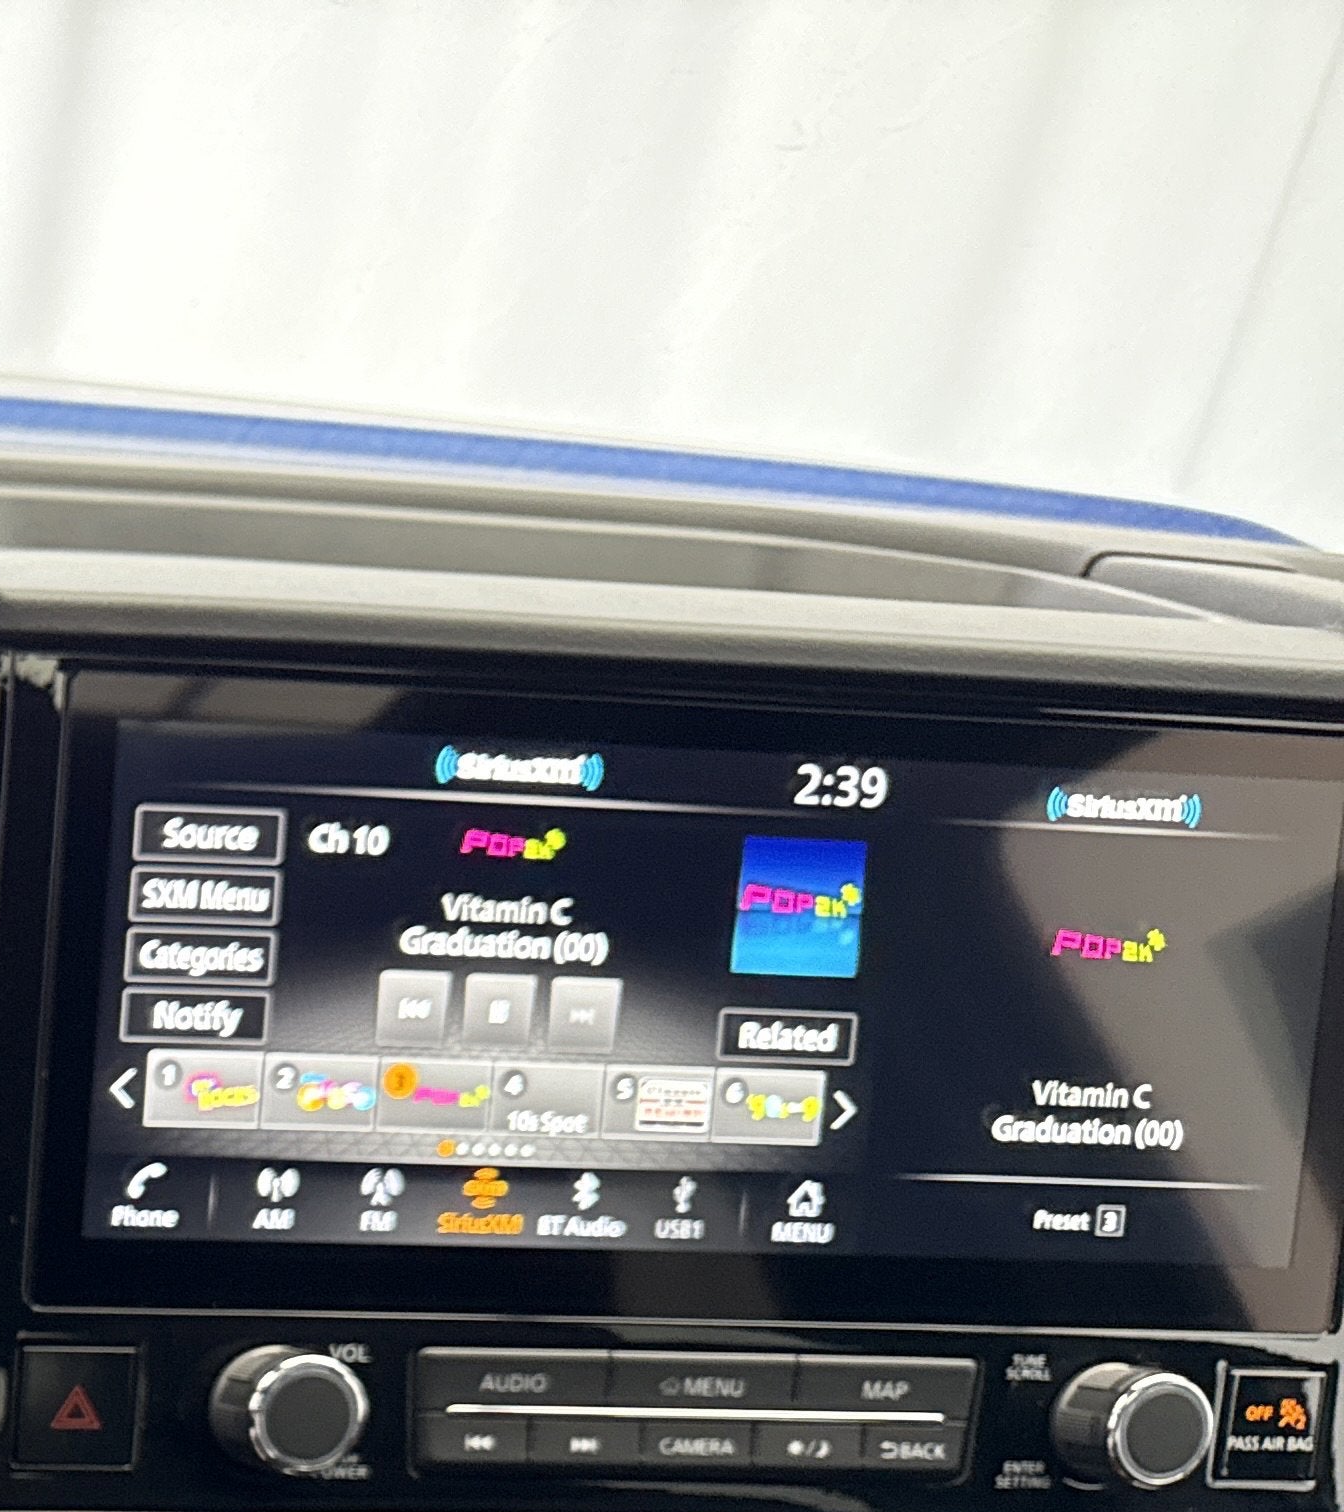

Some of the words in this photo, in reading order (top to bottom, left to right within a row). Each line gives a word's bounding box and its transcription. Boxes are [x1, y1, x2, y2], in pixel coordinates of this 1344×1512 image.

[793, 762, 889, 809] 2:39
[161, 816, 261, 852] Source
[308, 821, 350, 854] Ch
[352, 824, 391, 856] 10
[141, 877, 198, 911] SXM
[200, 879, 272, 914] Menu
[441, 891, 547, 925] Vitamin
[548, 898, 574, 926] C
[138, 938, 265, 977] Categories
[398, 924, 551, 960] Graduation
[552, 930, 610, 967] (00)
[151, 999, 245, 1038] Notify
[737, 1020, 841, 1053] Related
[161, 1063, 178, 1087] 1
[275, 1067, 296, 1091] 2
[1031, 1078, 1128, 1110] Vitamin
[1132, 1083, 1154, 1111] C
[540, 1110, 589, 1138] Spot
[990, 1113, 1133, 1147] Graduation
[1134, 1118, 1185, 1152] (00)
[110, 1204, 181, 1229] Phone
[252, 1207, 297, 1230] AM
[359, 1210, 399, 1232] FM
[535, 1213, 564, 1237] BT
[565, 1215, 629, 1239] Audio
[1032, 1209, 1090, 1233] Preset
[770, 1220, 836, 1245] MENU
[328, 1342, 372, 1363] VOL
[479, 1372, 549, 1394] AUDIO
[683, 1375, 747, 1400] MENU
[860, 1378, 910, 1402] MAP
[1244, 1405, 1274, 1422] OFF
[658, 1437, 736, 1458] CAMERA
[898, 1440, 946, 1463] BACK
[1226, 1435, 1259, 1451] PASS
[1261, 1436, 1285, 1452] AIR
[1286, 1437, 1315, 1453] BAG
